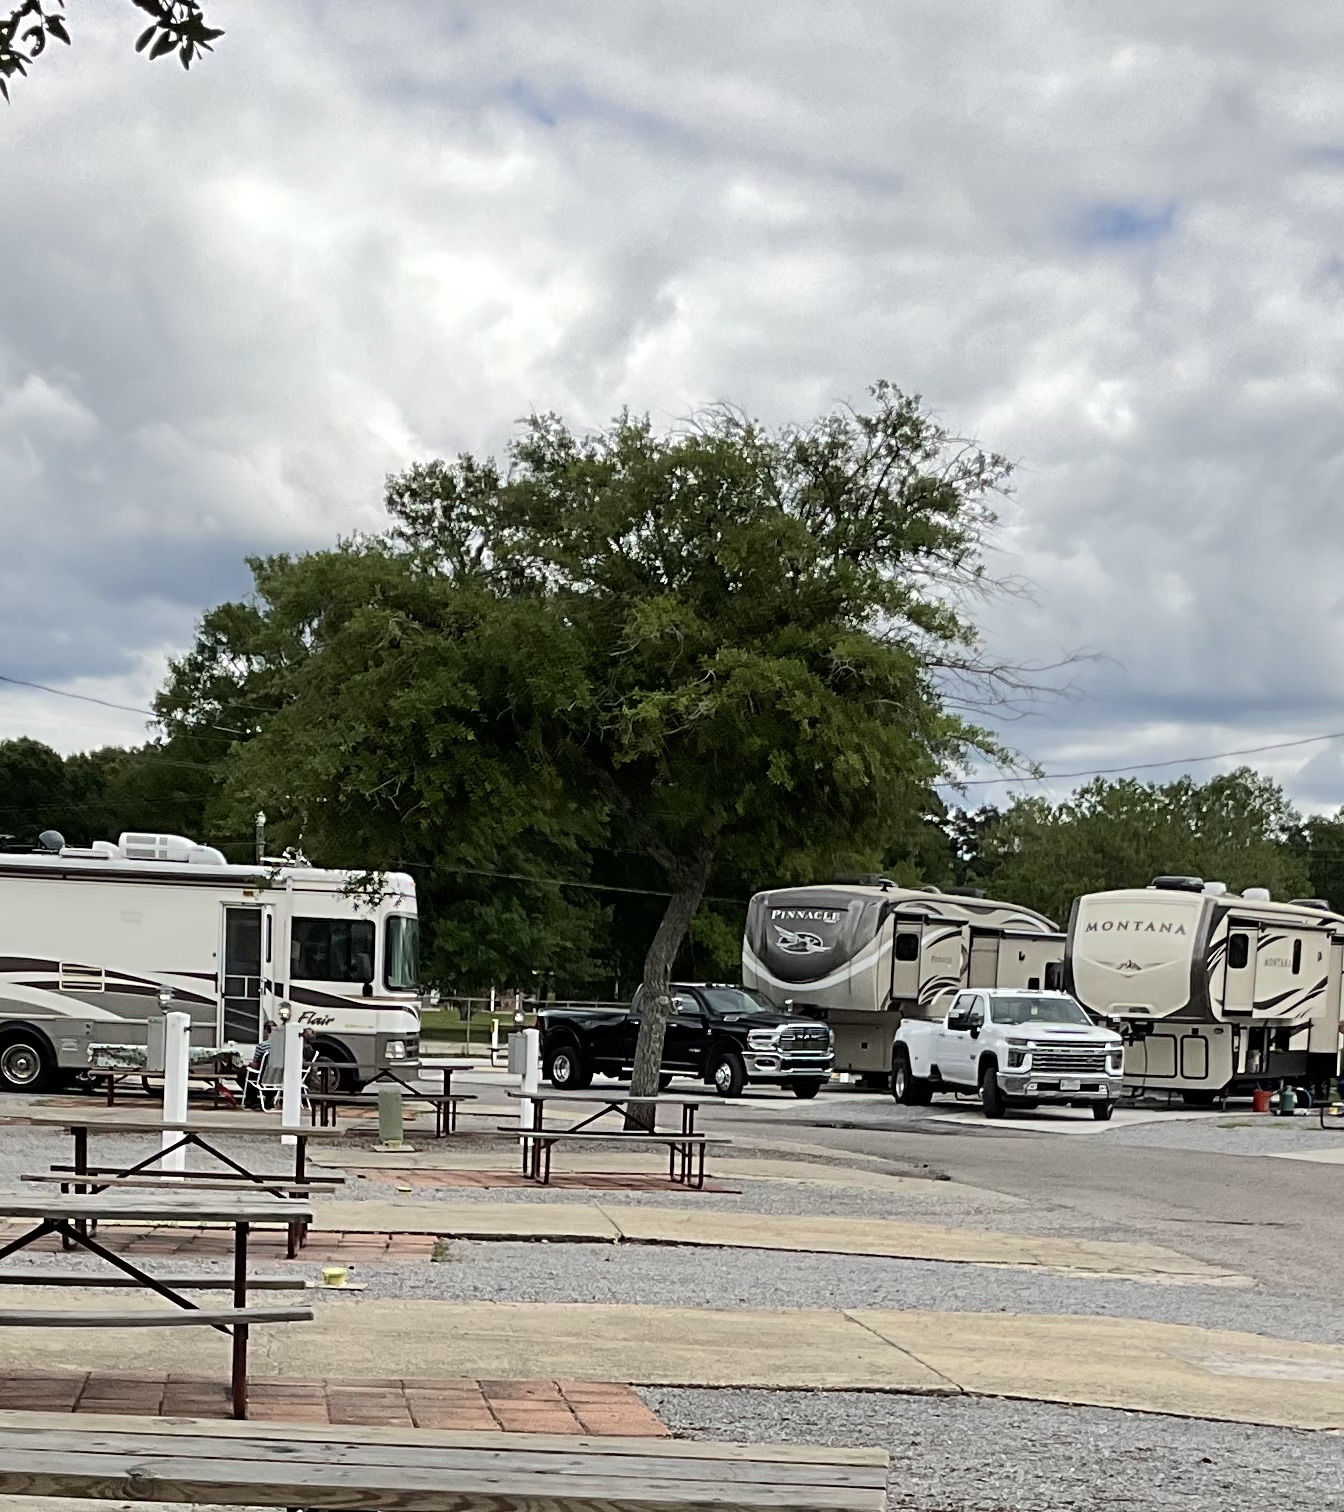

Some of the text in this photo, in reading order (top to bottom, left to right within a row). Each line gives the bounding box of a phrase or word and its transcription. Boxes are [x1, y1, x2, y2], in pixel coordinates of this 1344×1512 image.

[771, 909, 841, 921] PINNACLE
[1085, 920, 1187, 936] MONTANA
[297, 1011, 335, 1026] Flair
